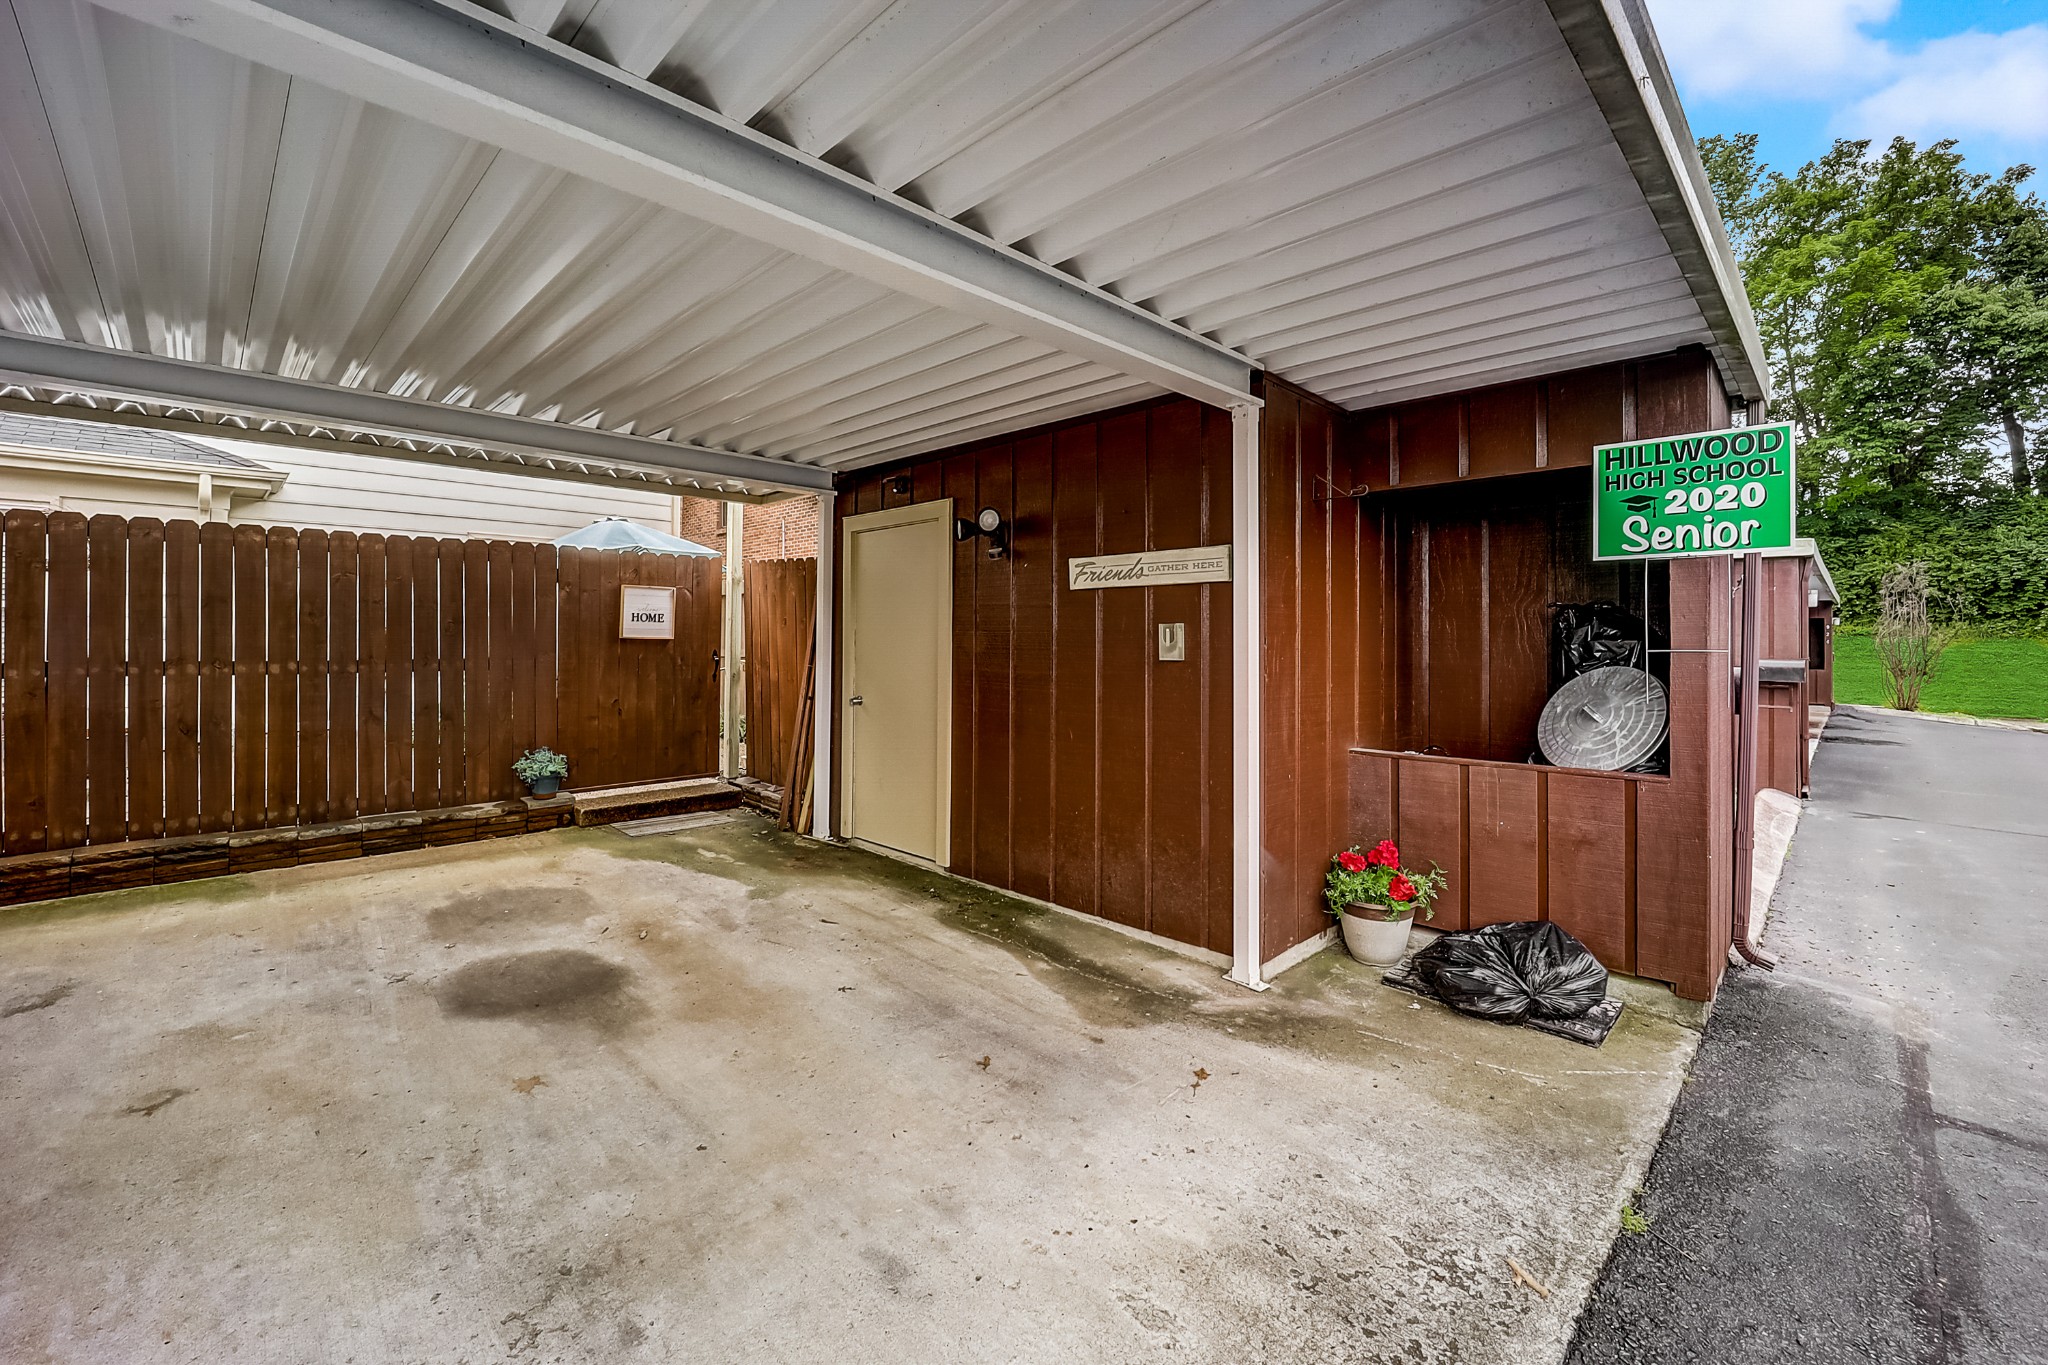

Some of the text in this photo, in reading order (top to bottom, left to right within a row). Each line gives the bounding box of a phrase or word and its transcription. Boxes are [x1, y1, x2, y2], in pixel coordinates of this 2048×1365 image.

[1605, 429, 1784, 472] HILLWOOD
[1605, 457, 1784, 492] HIGH SCHOOL
[1664, 481, 1767, 515] 2020
[1621, 514, 1761, 553] Senior
[1074, 557, 1223, 585] Friends GATHER HERE
[631, 612, 664, 623] HOME
